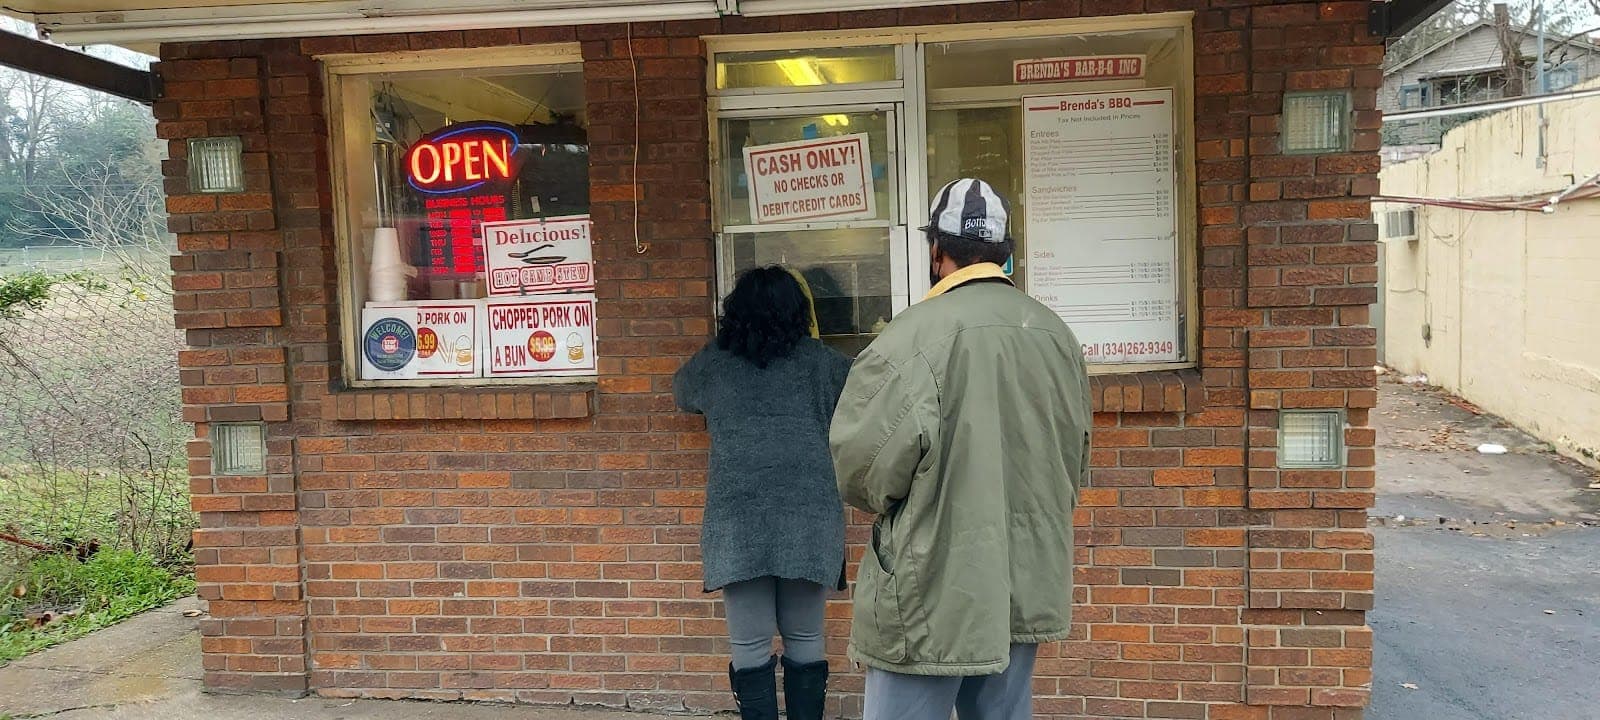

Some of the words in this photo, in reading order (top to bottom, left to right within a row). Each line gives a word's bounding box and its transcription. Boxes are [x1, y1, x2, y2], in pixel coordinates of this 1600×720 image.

[1020, 62, 1070, 80] BRENDA'S
[1075, 59, 1114, 76] BAR-B-Q
[1119, 58, 1137, 74] INC
[1060, 98, 1105, 111] Brenda's
[1108, 97, 1132, 109] BBQ
[1083, 114, 1111, 122] Included
[1030, 130, 1060, 138] Entrees
[411, 139, 509, 184] OPEN
[757, 153, 802, 176] CASH
[806, 145, 855, 170] ONLY!
[774, 179, 788, 193] NO
[791, 174, 829, 191] CHECKS
[831, 172, 845, 186] OR
[1031, 185, 1077, 194] Sandwiches
[471, 194, 504, 205] HOURS
[829, 193, 861, 208] CARDS
[495, 224, 587, 245] Delicious!
[1033, 249, 1056, 259] Sides
[495, 270, 517, 286] HOT
[521, 267, 552, 284] CAMP
[557, 265, 586, 281] STEW
[1034, 293, 1058, 302] Drinks
[425, 312, 450, 324] PORK
[454, 311, 467, 324] ON
[492, 307, 539, 330] CHOPPED
[542, 306, 571, 328] PORK
[574, 305, 589, 327] ON
[370, 323, 410, 340] WELCOME!
[417, 333, 435, 349] 6.99
[494, 345, 502, 366] A
[504, 345, 526, 367] BUN
[1080, 343, 1099, 356] Call
[1102, 341, 1173, 358] (334)262-9349
